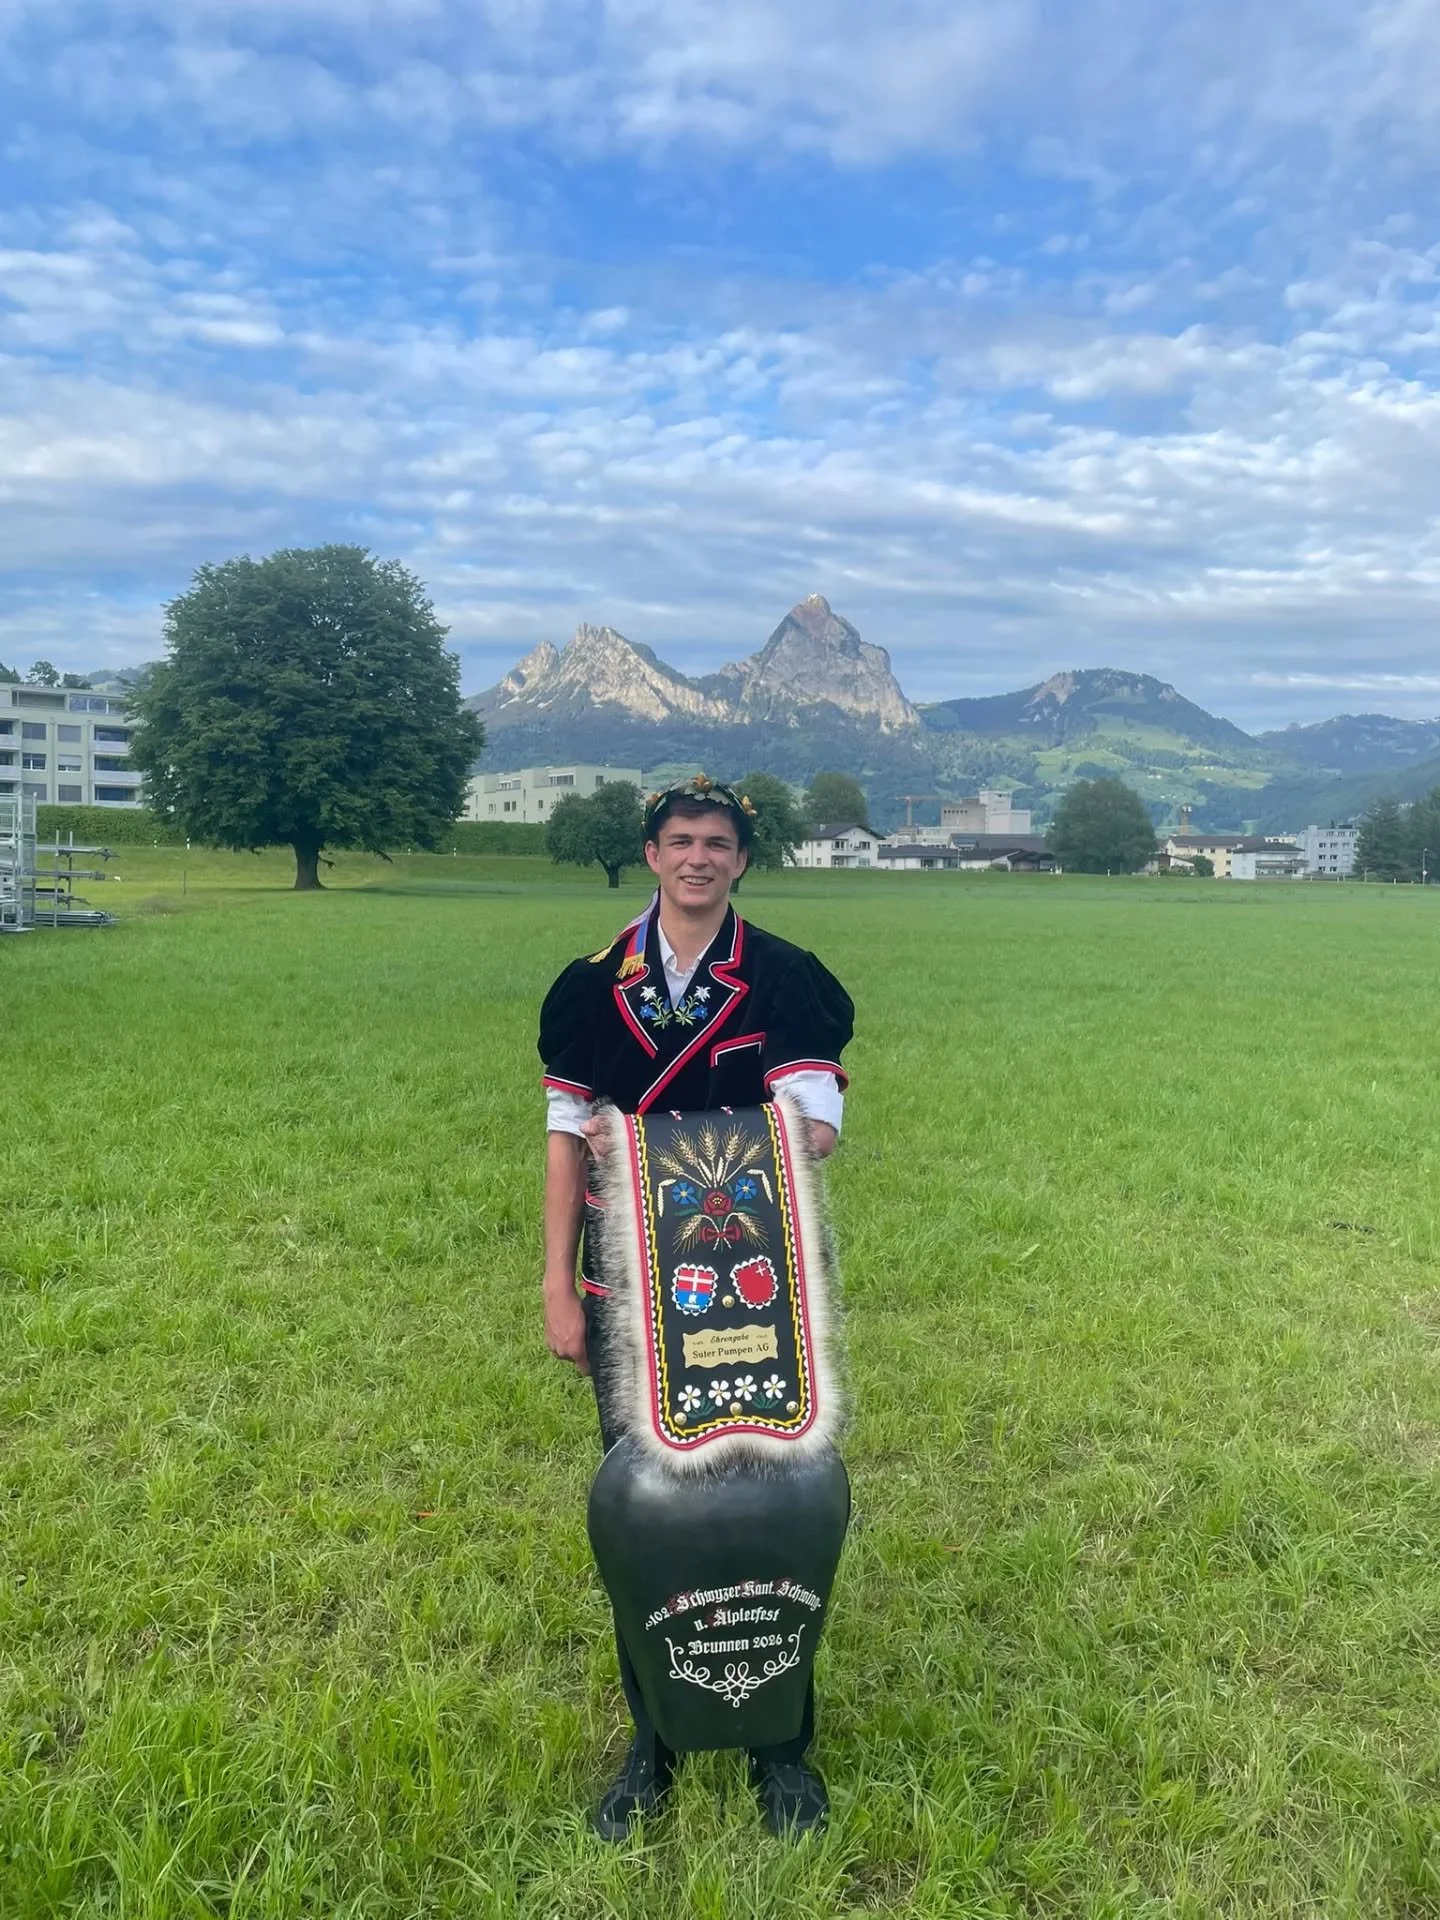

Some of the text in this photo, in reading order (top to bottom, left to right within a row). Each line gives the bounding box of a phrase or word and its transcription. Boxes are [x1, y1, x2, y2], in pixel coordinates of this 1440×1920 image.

[692, 1343, 770, 1359] Suter Pumpen AG
[676, 1586, 741, 1611] Schwyzer
[688, 1634, 783, 1655] Brunnen 2026
